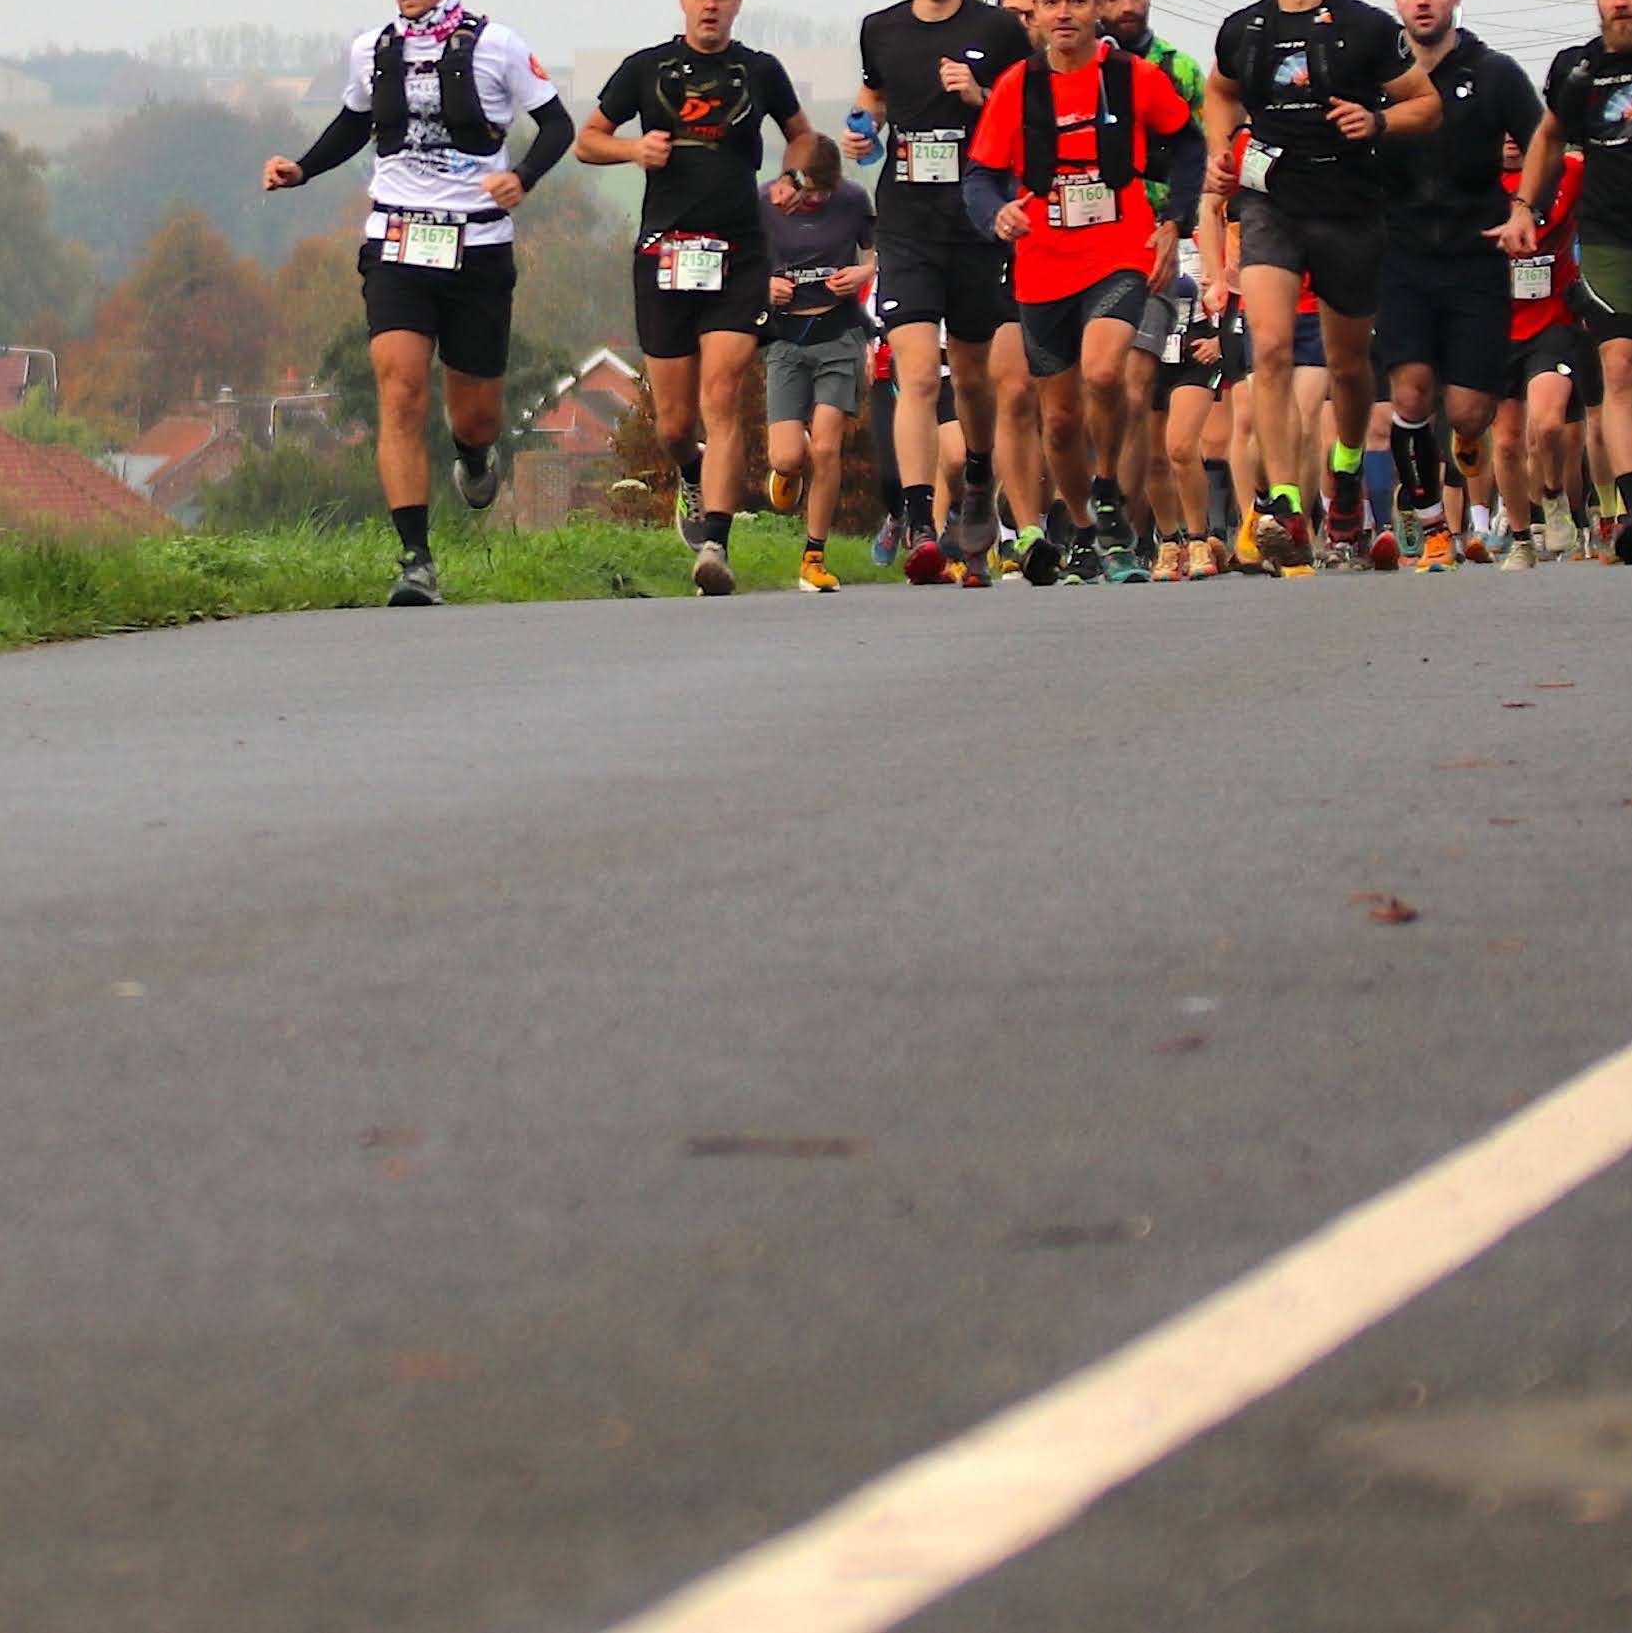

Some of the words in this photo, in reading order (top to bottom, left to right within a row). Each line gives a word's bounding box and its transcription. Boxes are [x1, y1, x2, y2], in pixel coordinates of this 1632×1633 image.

[915, 145, 956, 159] 21627
[411, 227, 455, 243] 21675
[681, 253, 720, 268] 21573
